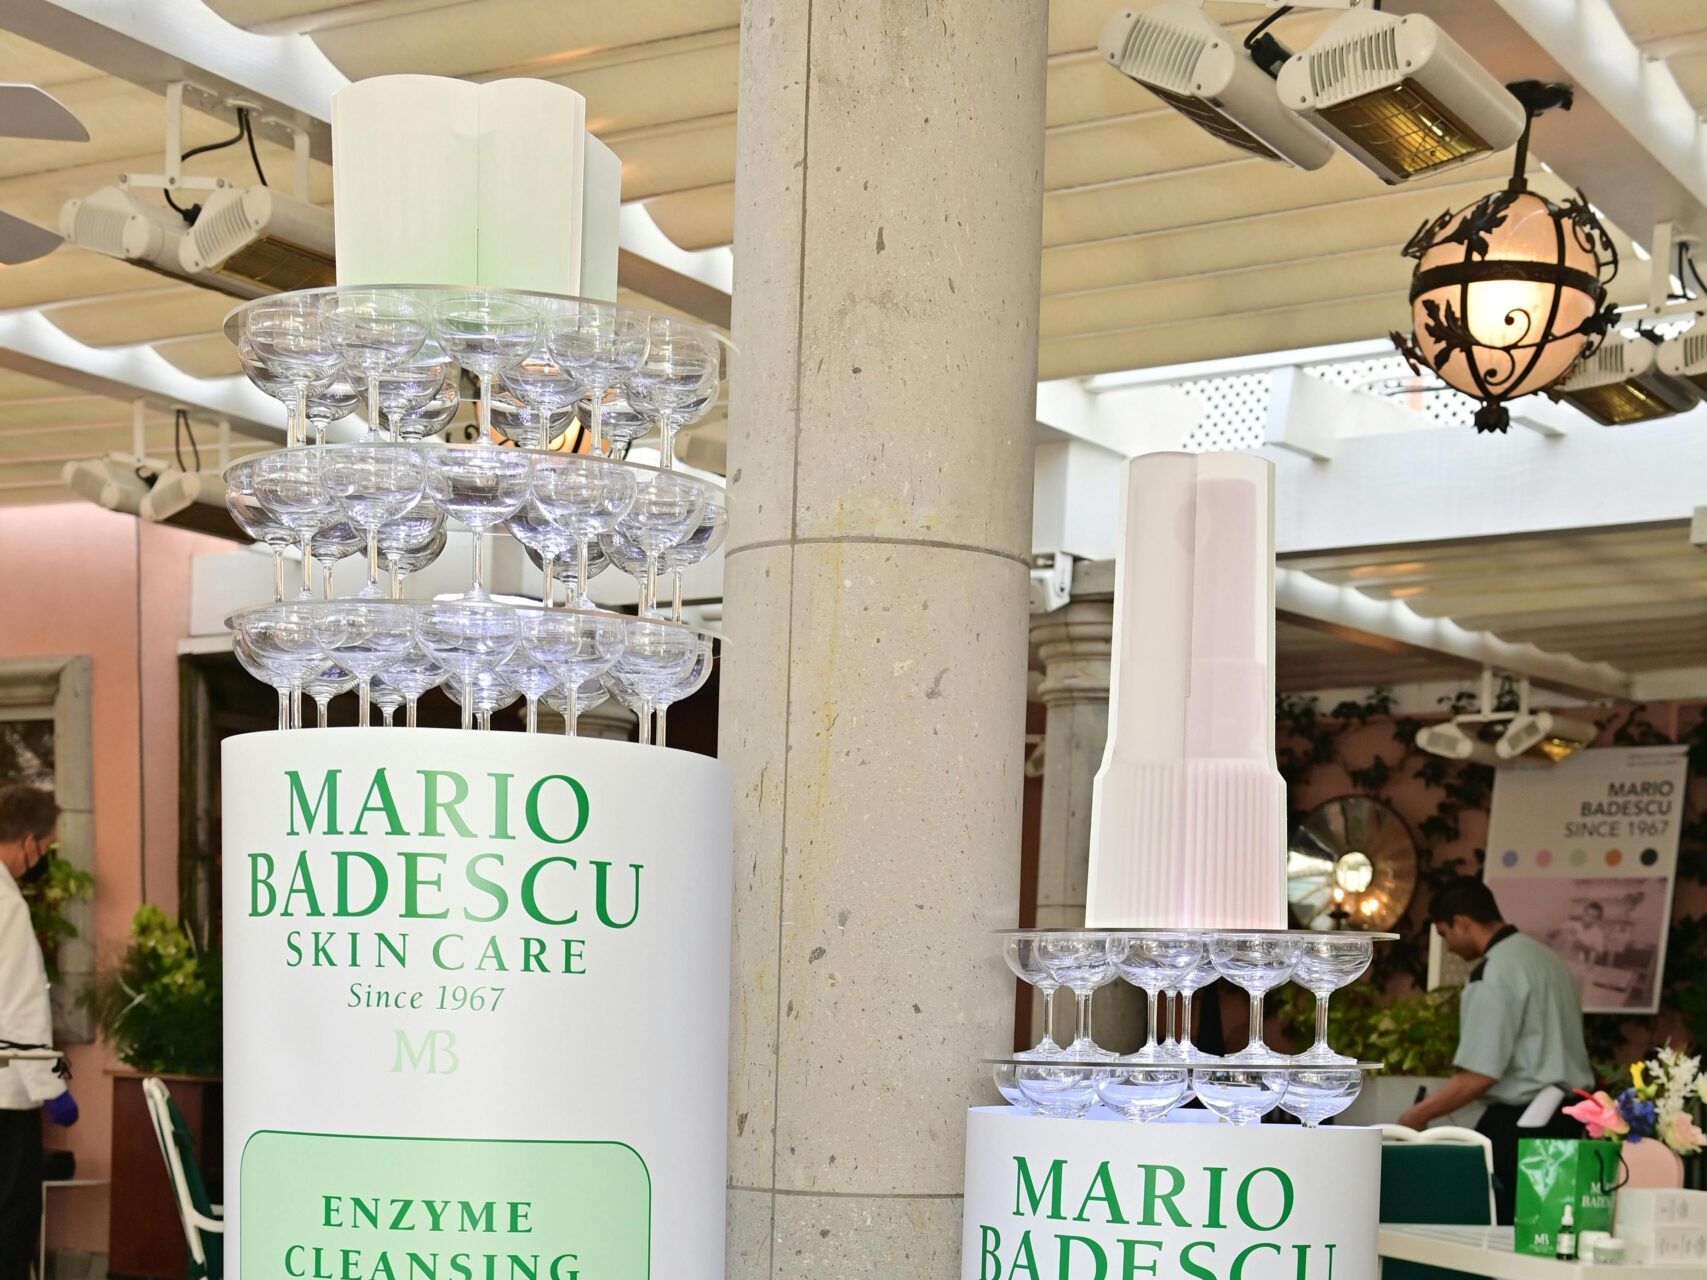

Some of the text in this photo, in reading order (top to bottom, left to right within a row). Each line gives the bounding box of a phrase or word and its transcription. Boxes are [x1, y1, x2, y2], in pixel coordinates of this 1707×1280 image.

[285, 767, 590, 845] MARIO
[1580, 800, 1673, 818] BADESCU
[1607, 780, 1675, 798] MARIO
[1563, 820, 1670, 839] SINCE 1967
[248, 849, 644, 929] BADESCU
[286, 930, 587, 975] SKIN CARE
[347, 982, 505, 1012] Since 1967
[1012, 1155, 1295, 1232] MARIO
[321, 1194, 534, 1234] ENZYME
